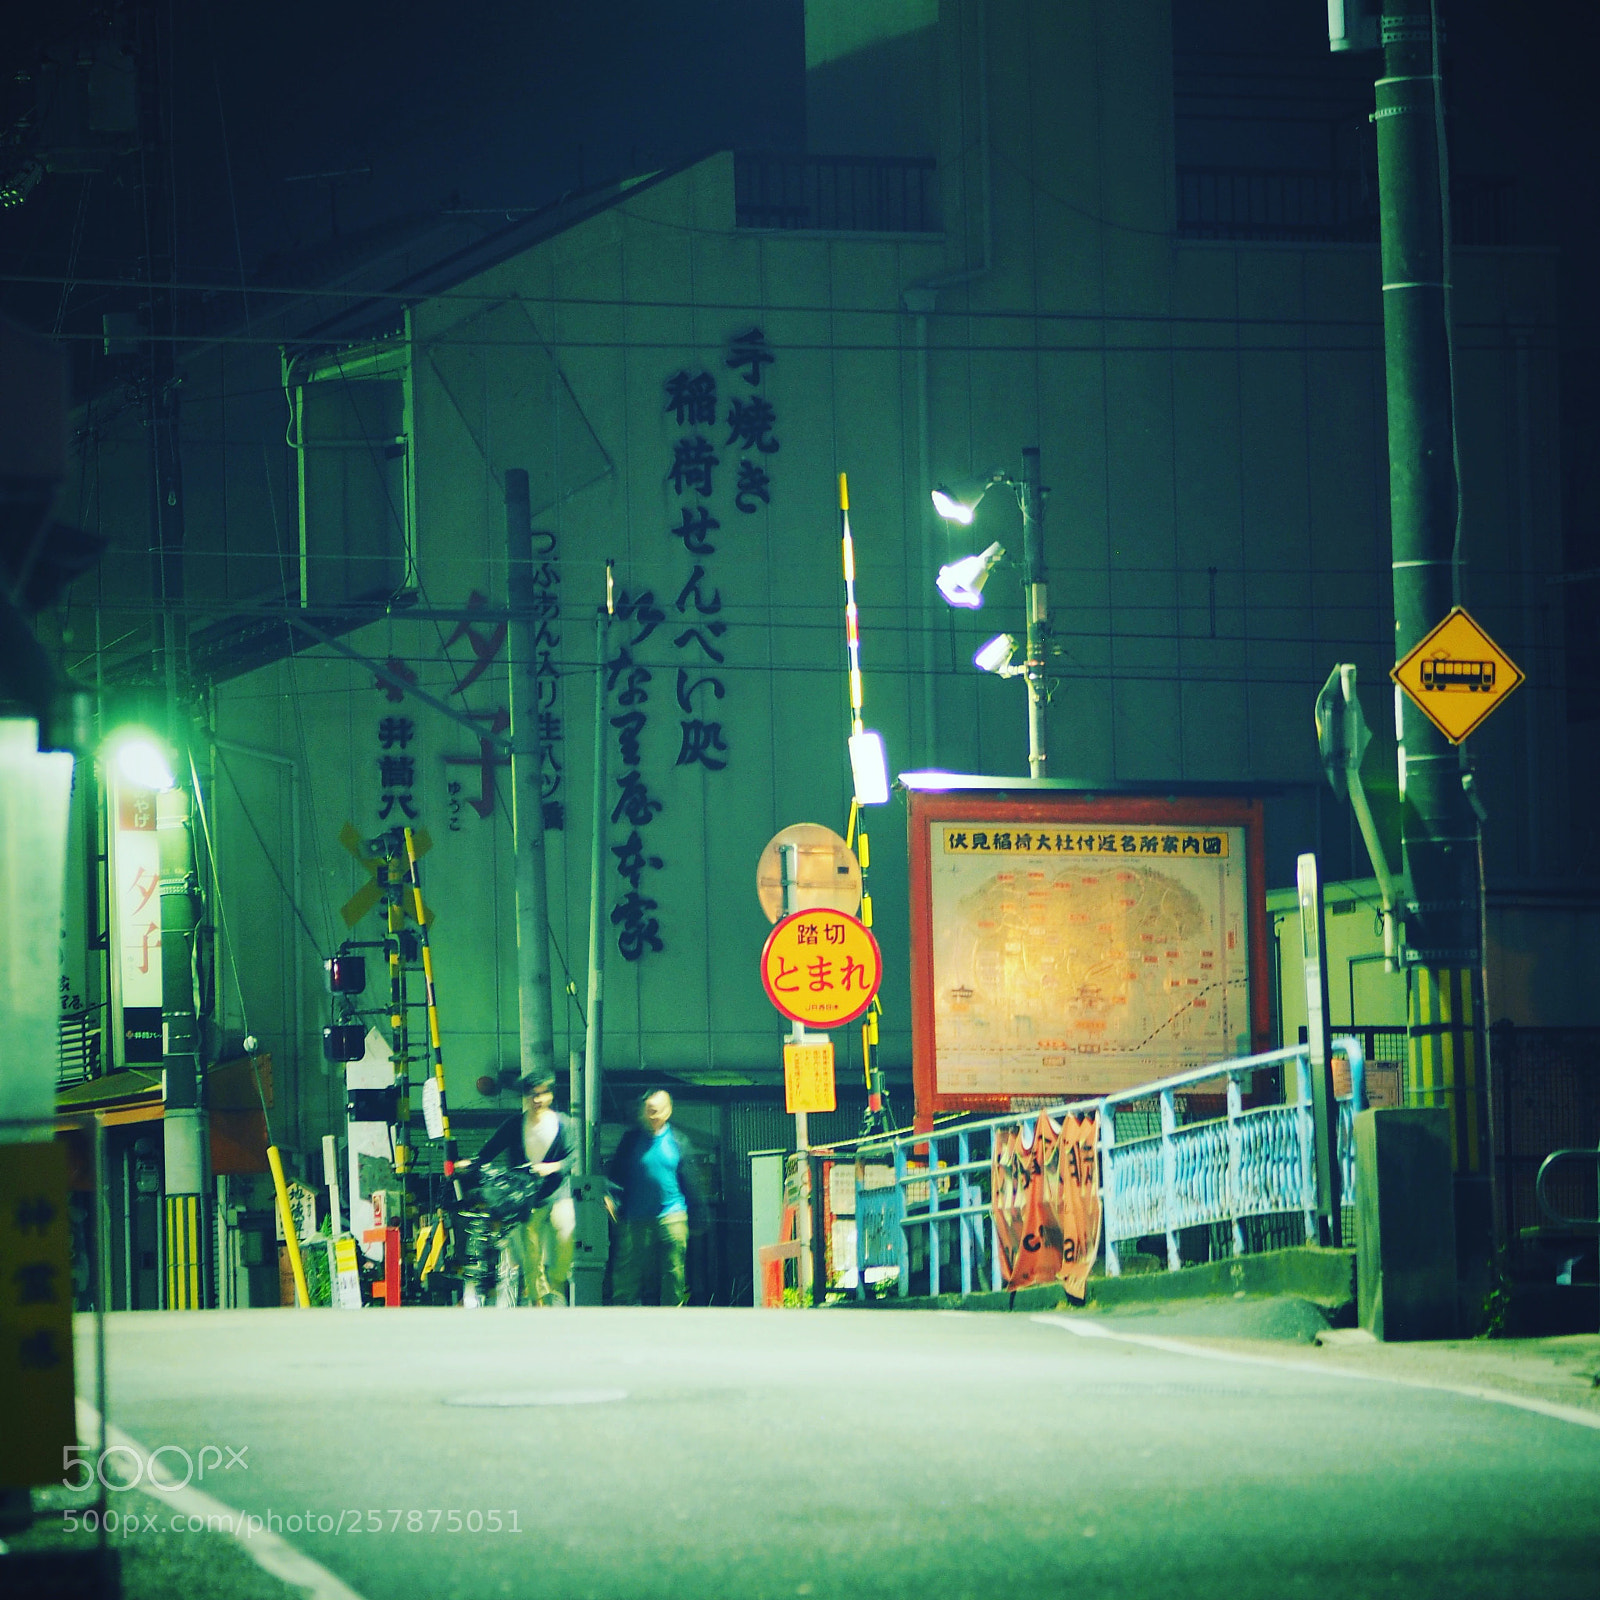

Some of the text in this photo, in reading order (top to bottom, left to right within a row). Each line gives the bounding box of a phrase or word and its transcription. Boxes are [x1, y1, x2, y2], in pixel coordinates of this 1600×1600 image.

[727, 328, 779, 513] 手焼き
[664, 370, 729, 772] 稲荷せんべい処
[948, 831, 1222, 856] 伏見稲荷大社付近名所案内図
[127, 866, 162, 975] 夕子
[797, 923, 846, 945] 踏切
[773, 955, 871, 992] とまれ
